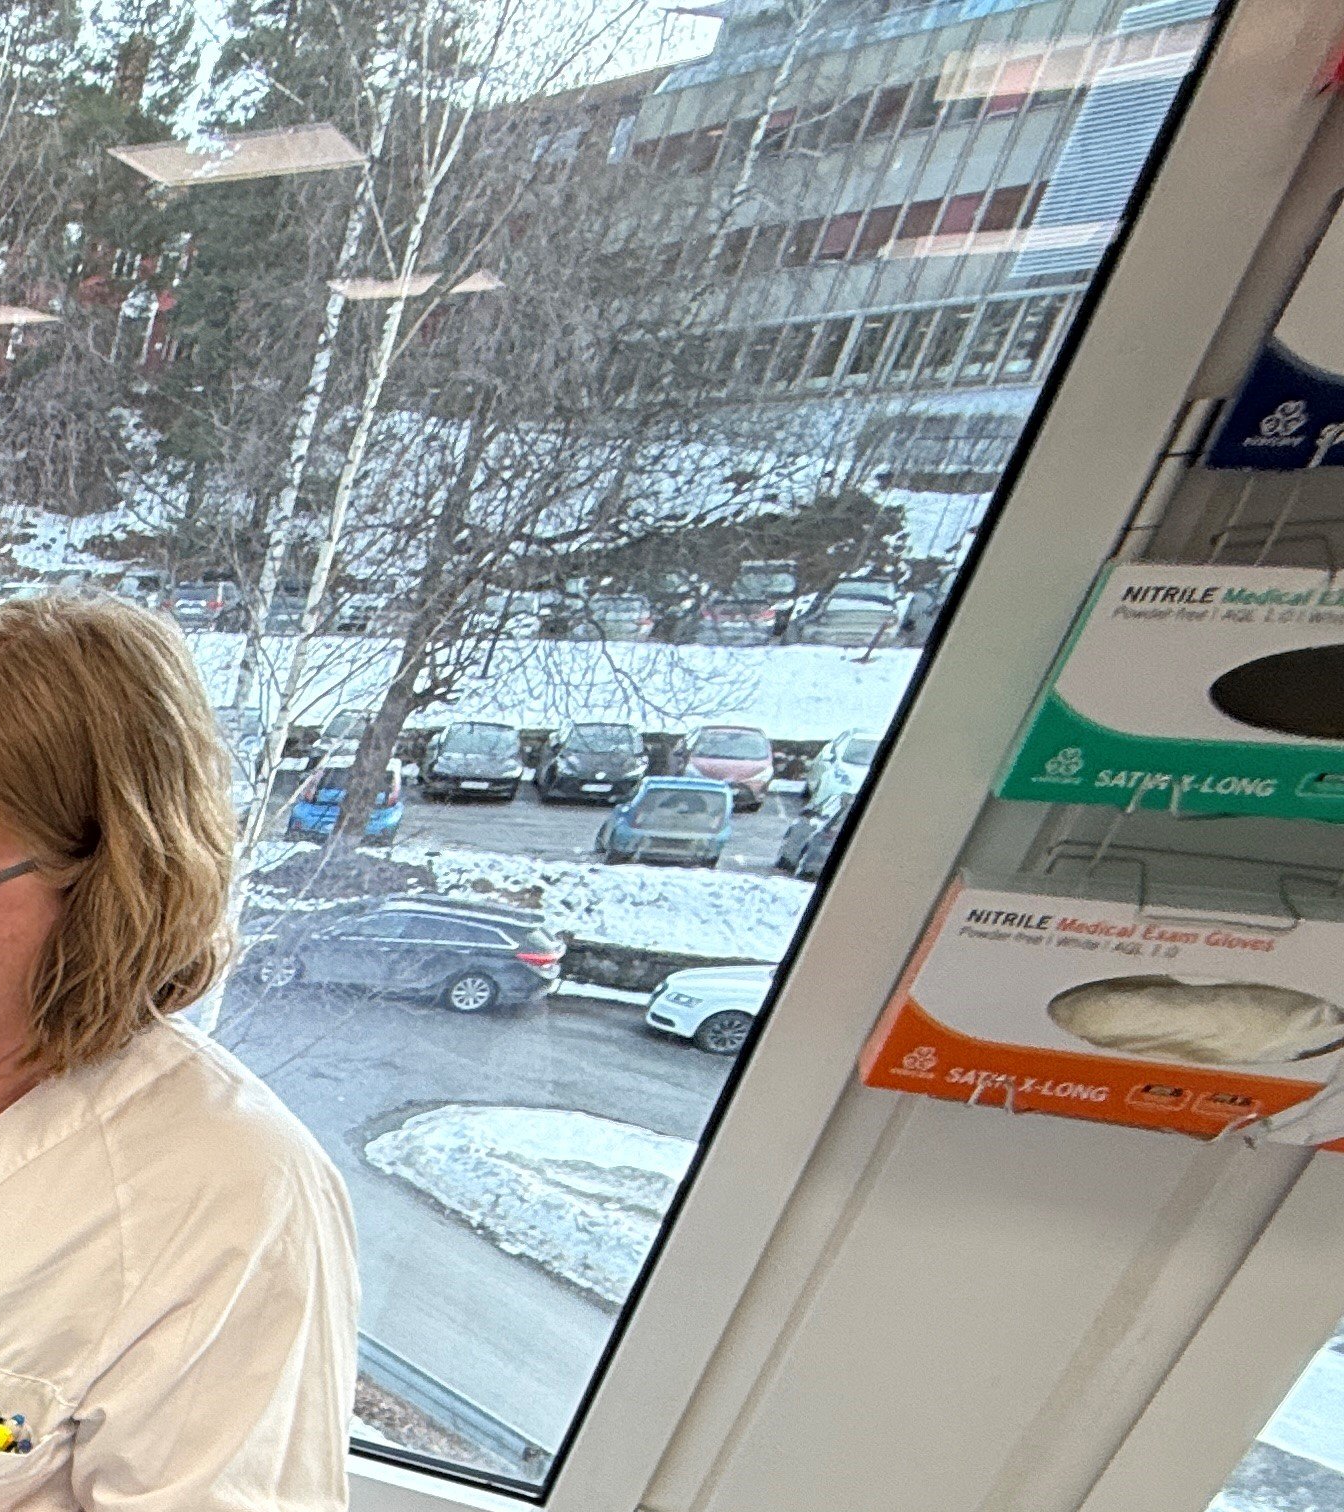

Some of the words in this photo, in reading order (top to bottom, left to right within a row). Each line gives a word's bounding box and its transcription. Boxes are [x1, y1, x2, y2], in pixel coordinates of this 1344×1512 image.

[1121, 586, 1220, 604] NITRILE
[1222, 587, 1312, 606] Medical
[967, 909, 1053, 930] NITRILE
[1056, 916, 1138, 938] Medical
[1142, 922, 1201, 943] Exam
[1205, 930, 1276, 952] Gloves
